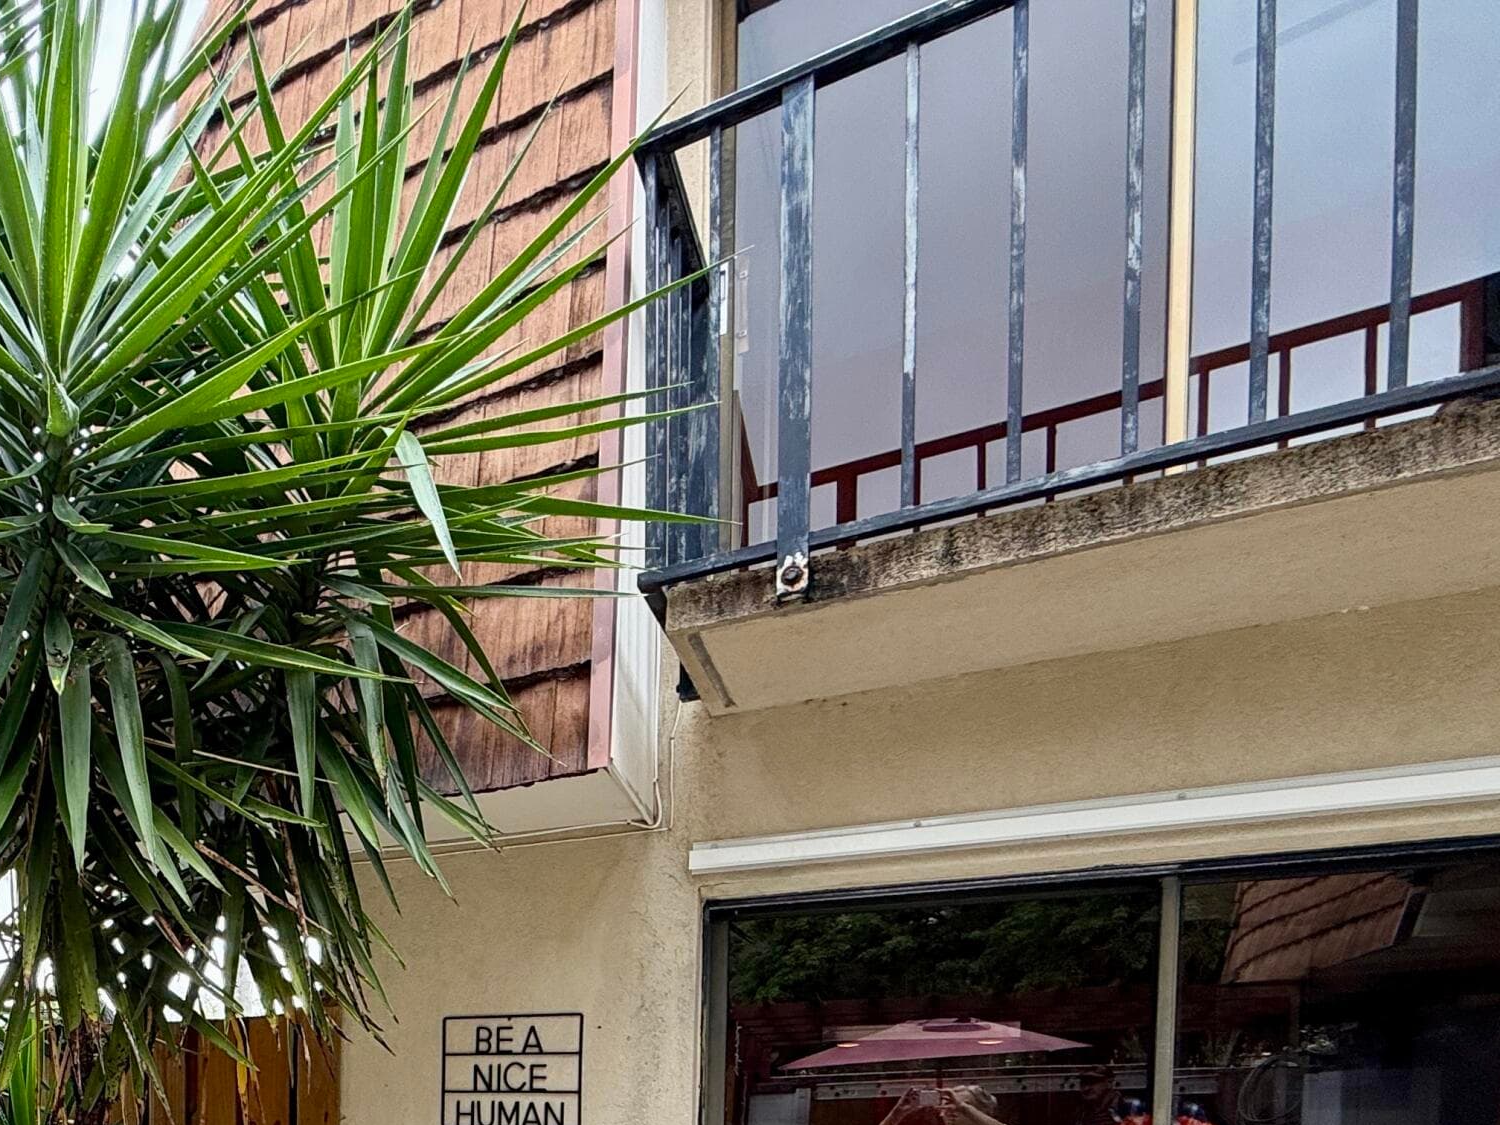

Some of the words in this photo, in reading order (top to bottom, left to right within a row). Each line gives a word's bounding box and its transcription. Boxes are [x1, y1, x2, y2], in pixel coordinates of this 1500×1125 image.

[475, 1026, 513, 1054] BE
[522, 1025, 543, 1053] A
[474, 1062, 547, 1091] NICE
